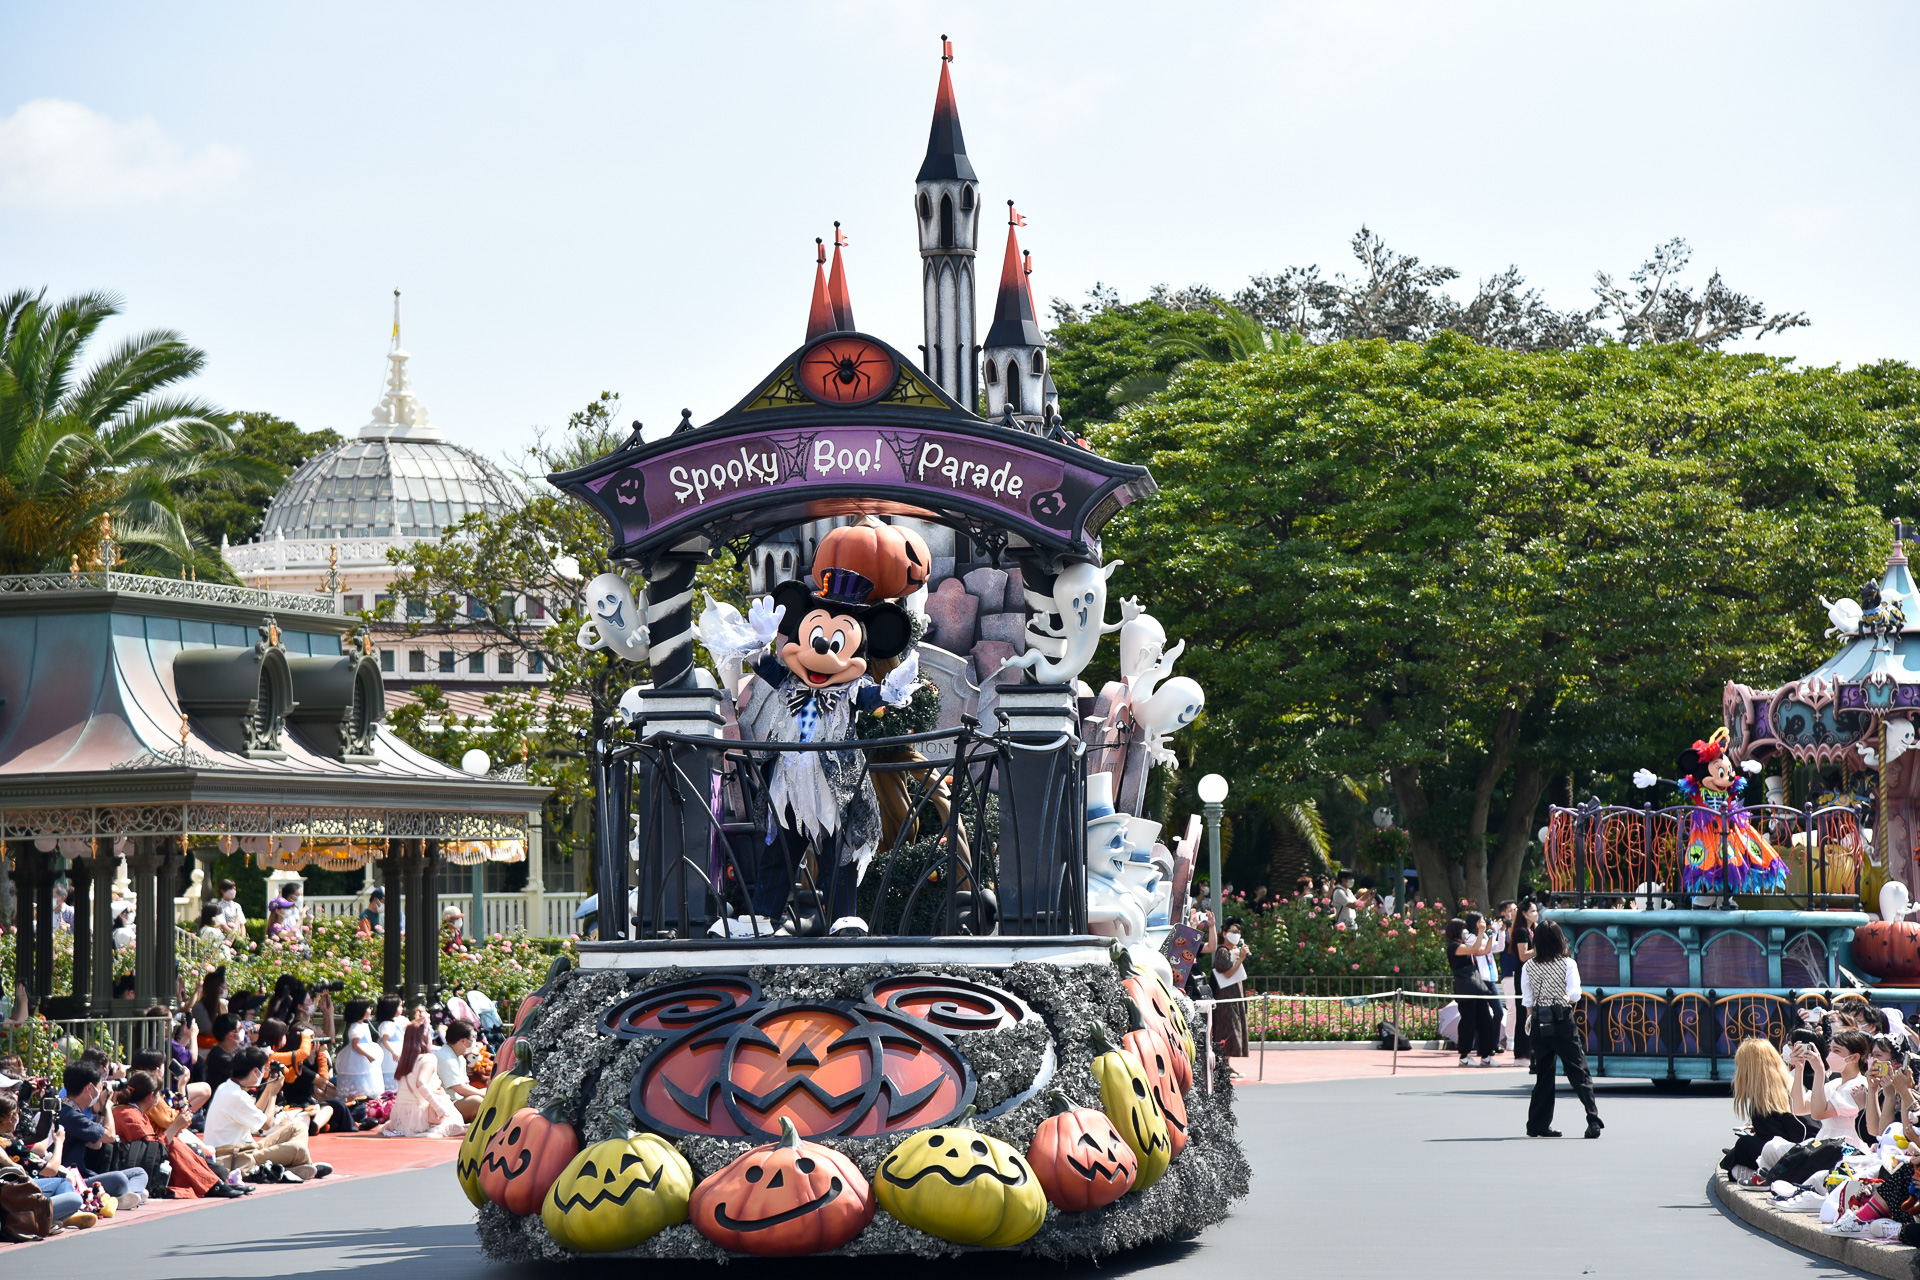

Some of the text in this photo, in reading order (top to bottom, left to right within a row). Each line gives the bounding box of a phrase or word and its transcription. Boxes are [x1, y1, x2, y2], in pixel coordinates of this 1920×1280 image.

[669, 438, 1024, 504] Spooky Boo! Parade
[912, 741, 950, 755] ION
